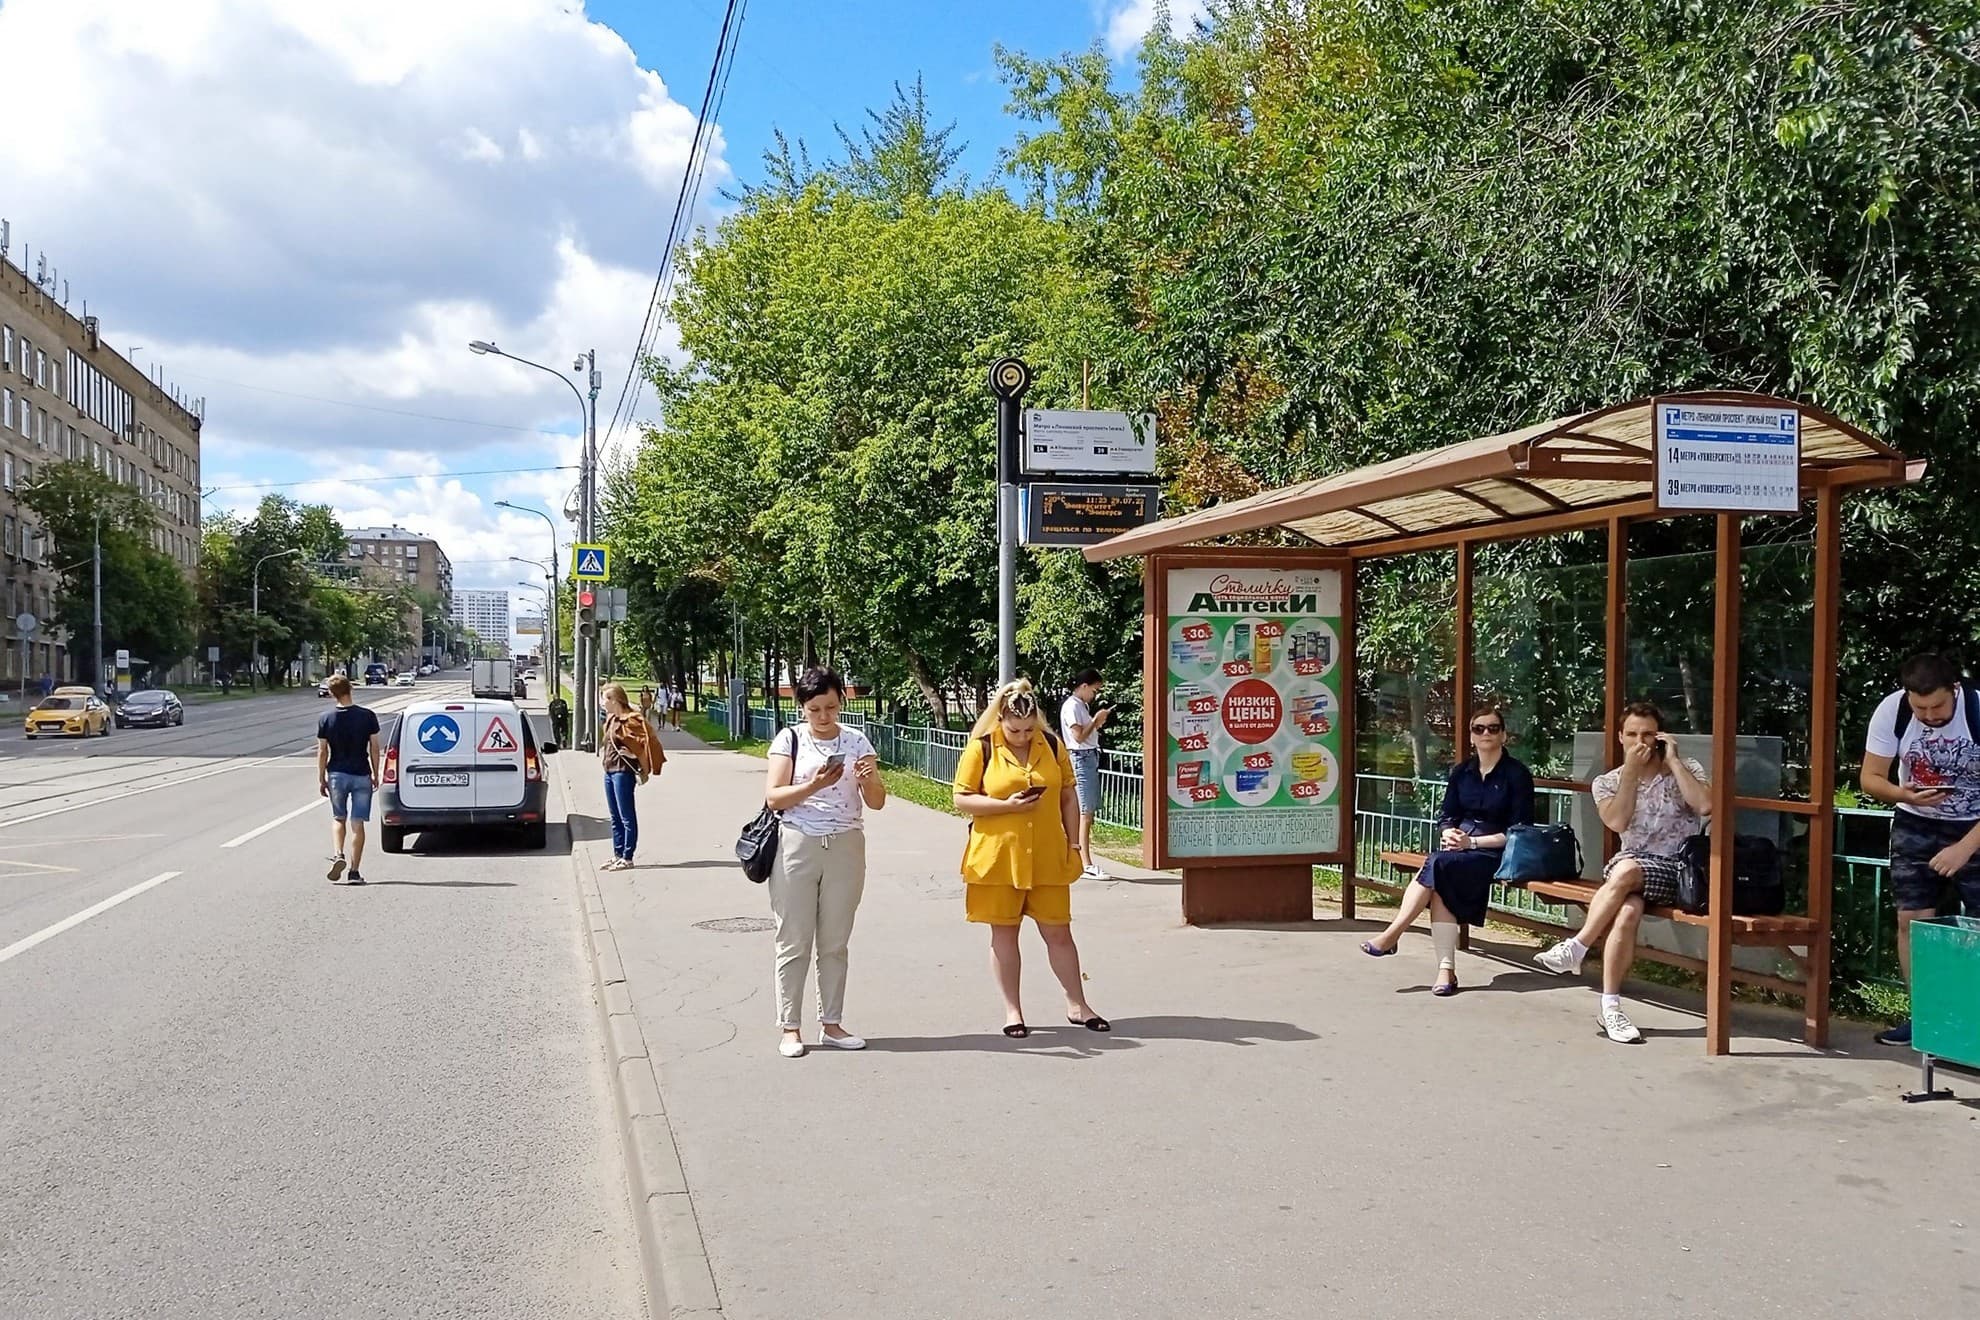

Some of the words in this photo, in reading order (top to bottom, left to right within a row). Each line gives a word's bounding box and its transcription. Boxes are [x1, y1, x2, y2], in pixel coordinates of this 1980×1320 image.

[1668, 447, 1679, 463] 14
[1680, 451, 1696, 460] МЕТРО
[1668, 480, 1679, 495] 39
[1680, 483, 1696, 492] МЕТРО
[1209, 574, 1294, 594] Столички
[1228, 696, 1276, 707] НИЗКИЕ
[1229, 707, 1275, 722] ЦЕНЫ
[1285, 817, 1334, 832] НЕОБХОДИМО
[1216, 831, 1277, 847] КОНСУЛЬТАЦИИ
